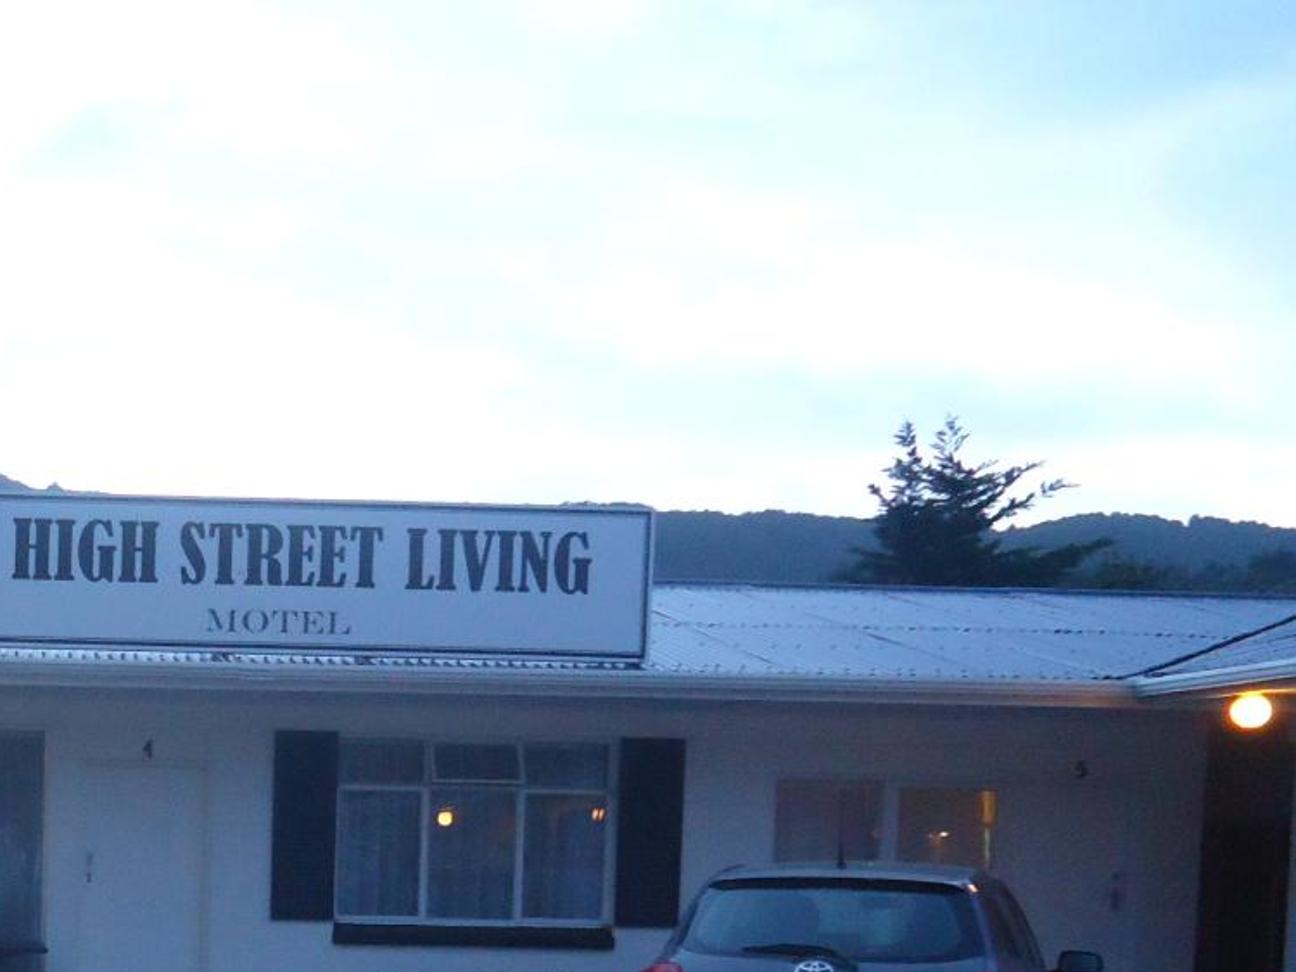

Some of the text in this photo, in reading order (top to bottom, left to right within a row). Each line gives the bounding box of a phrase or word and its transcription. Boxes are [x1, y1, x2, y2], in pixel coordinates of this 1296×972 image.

[12, 518, 592, 595] HIGH STREET LIVING
[207, 608, 352, 636] MOTEL
